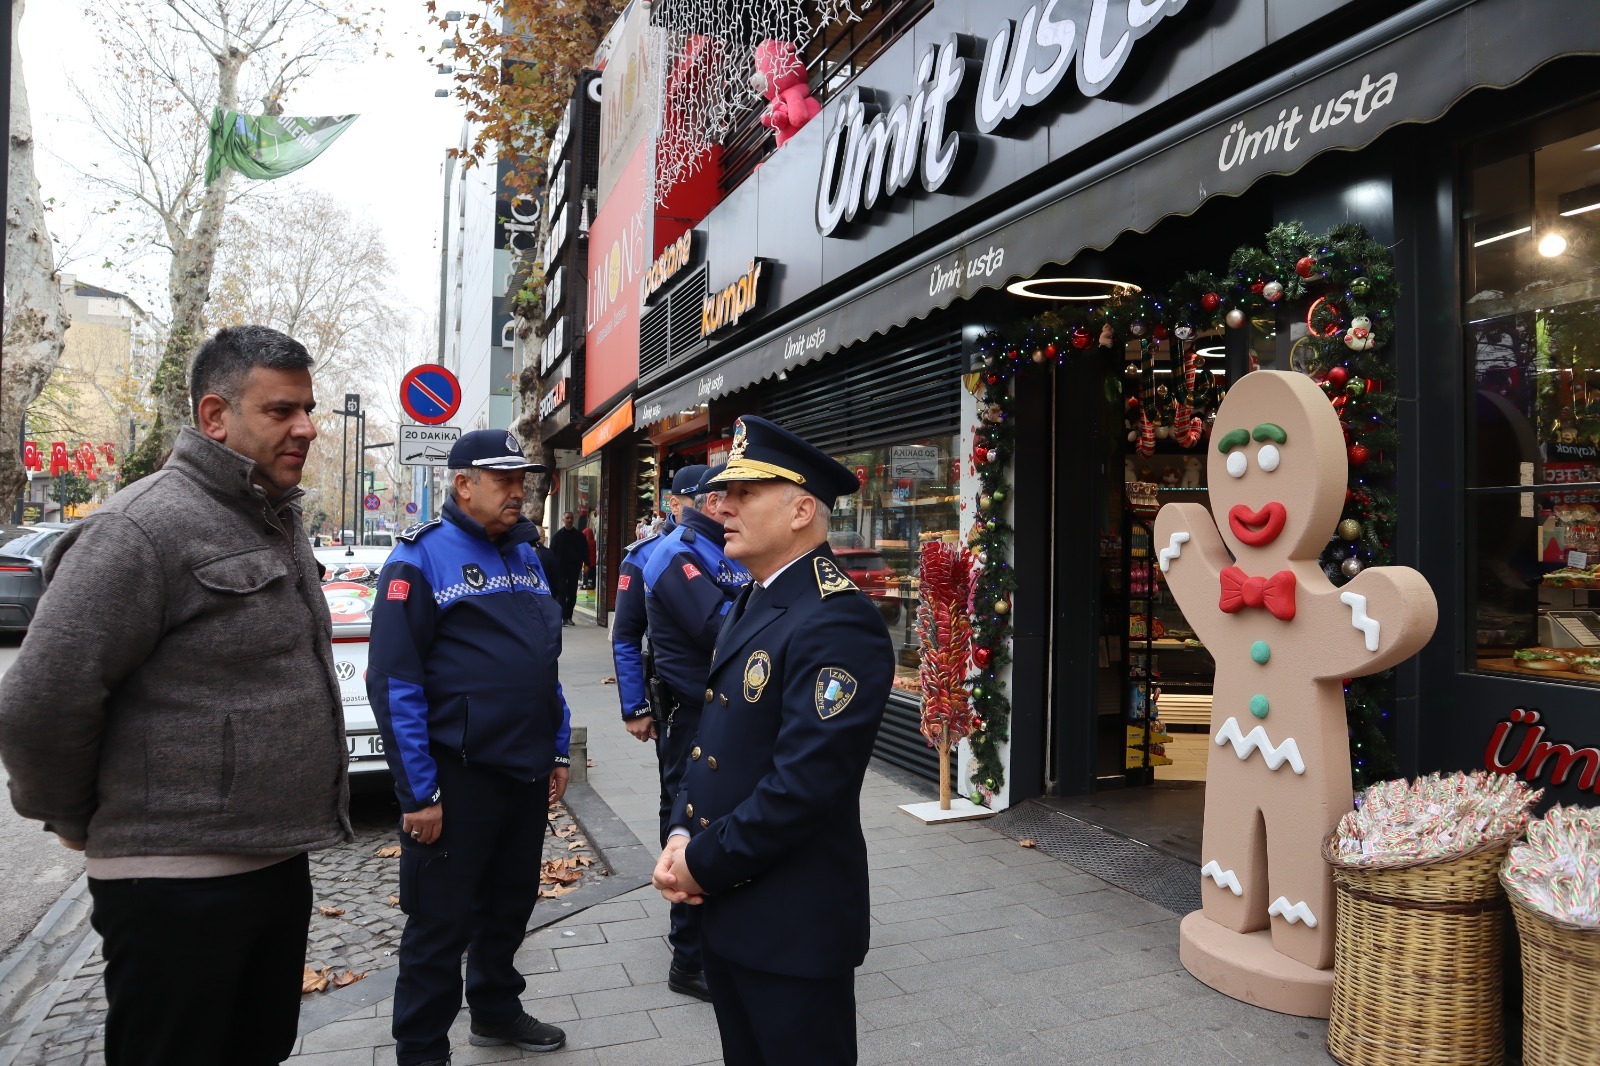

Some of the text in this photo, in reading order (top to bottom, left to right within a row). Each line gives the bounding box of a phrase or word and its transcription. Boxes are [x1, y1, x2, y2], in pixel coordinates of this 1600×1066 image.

[815, 32, 966, 238] Ümit
[1218, 71, 1398, 171] Ümit usta
[643, 229, 692, 303] pastane
[701, 260, 762, 337] kumpir
[929, 246, 1005, 297] Ümit usta
[784, 326, 826, 360] Ümit usta
[405, 430, 457, 440] 20 DAKİKA
[1484, 708, 1600, 796] Üm
